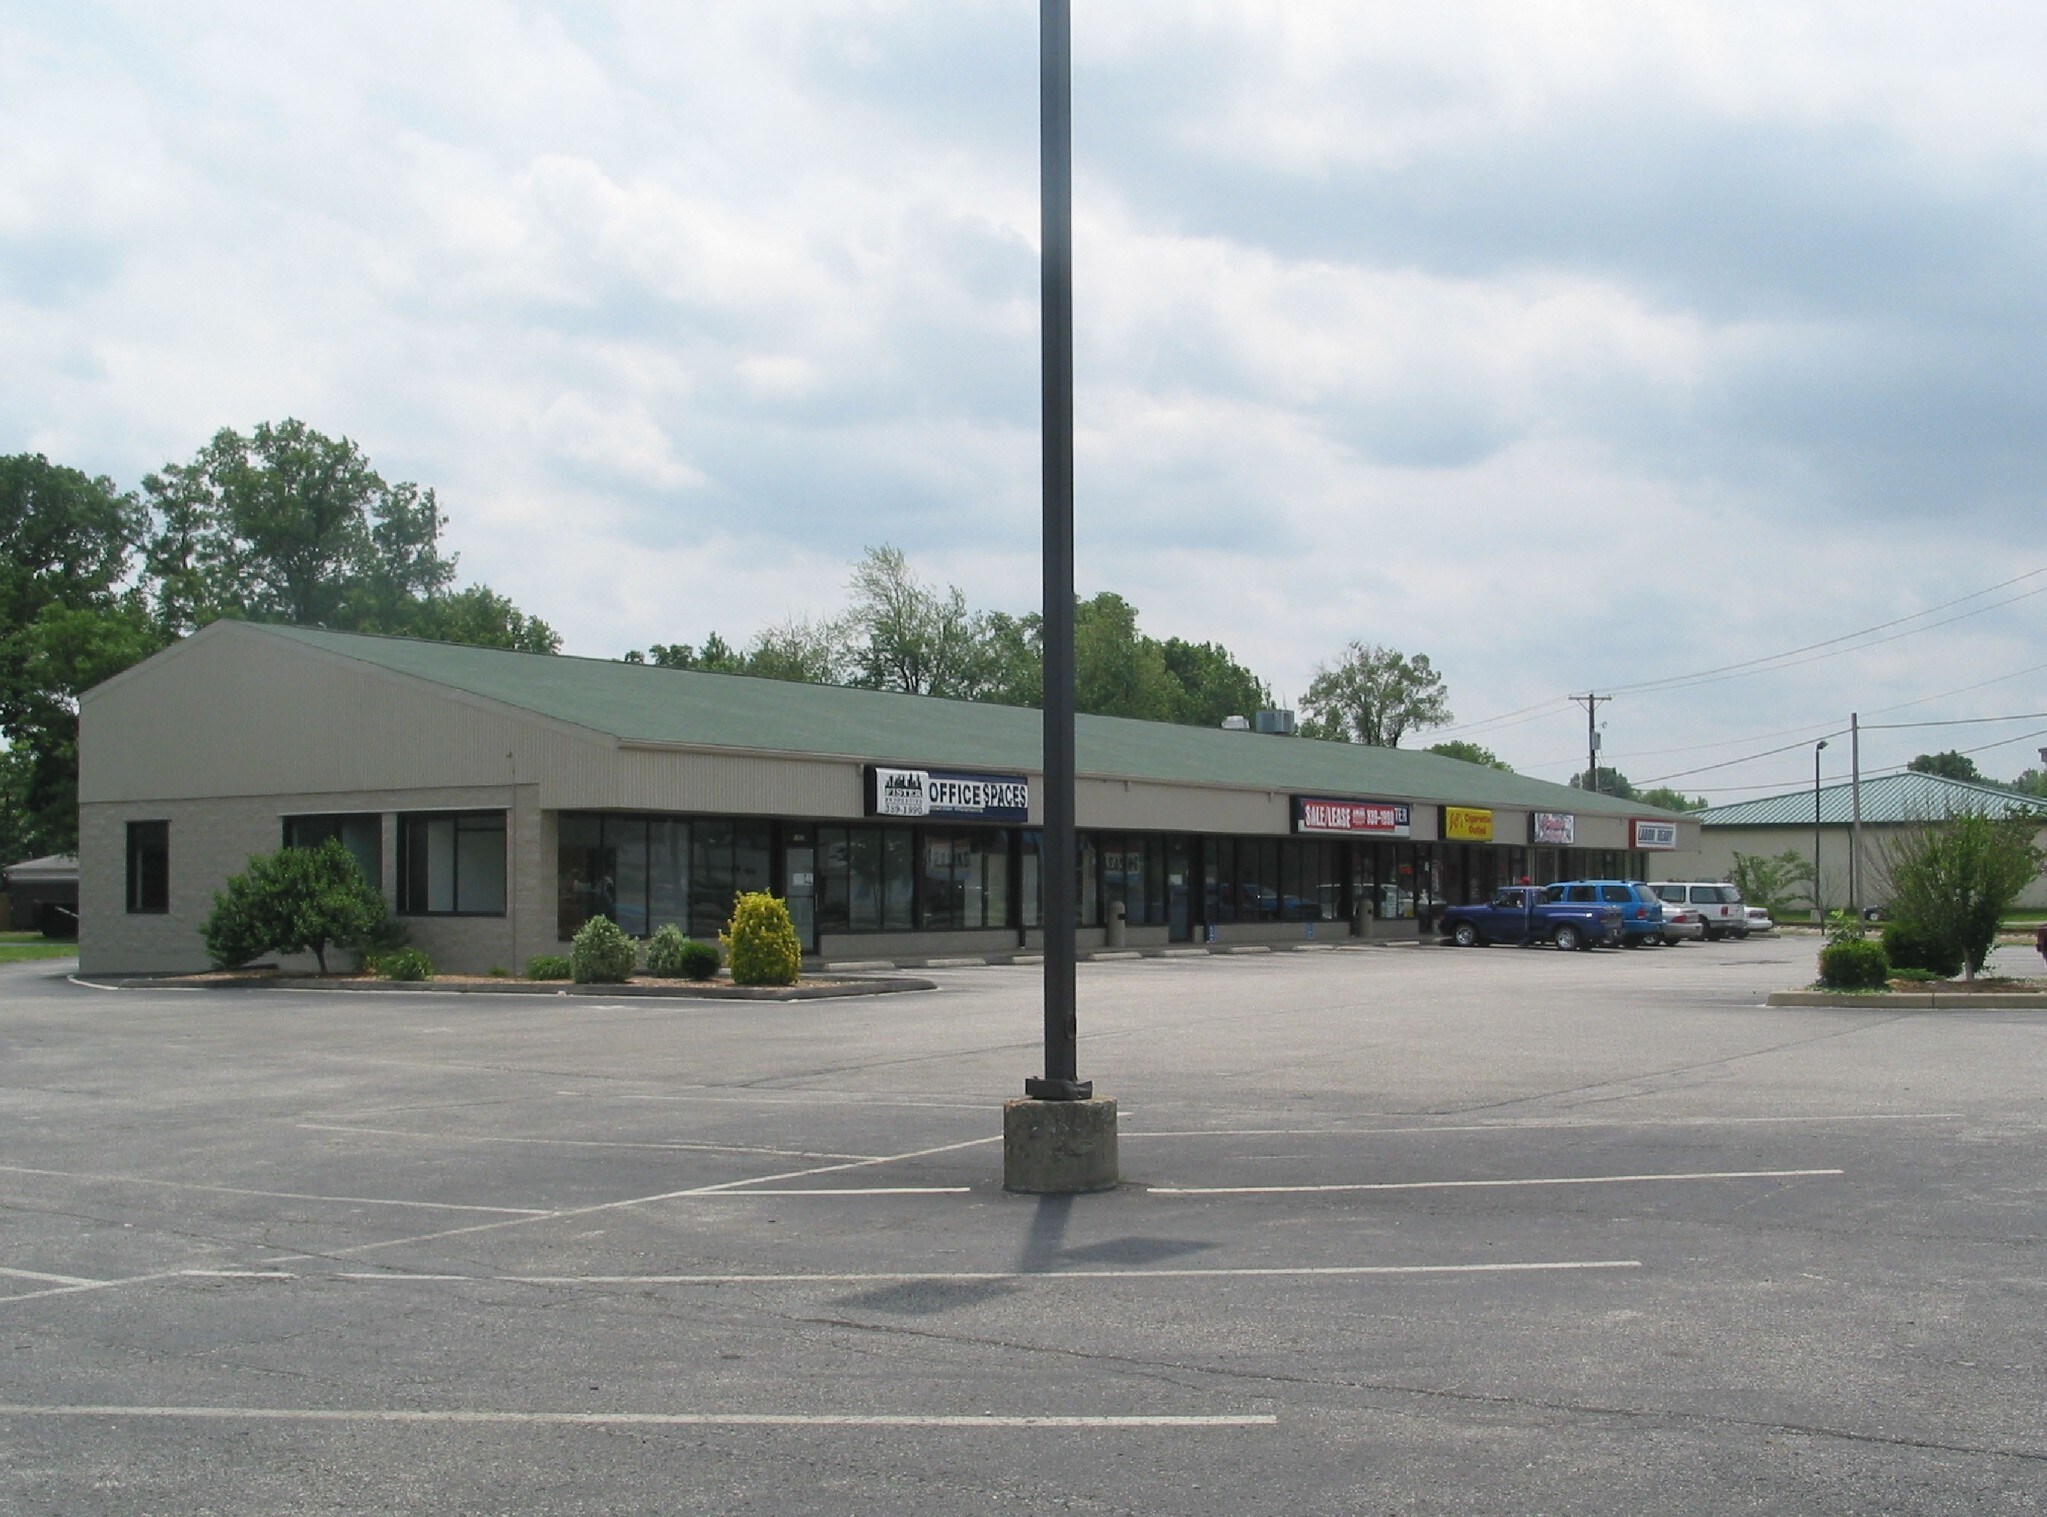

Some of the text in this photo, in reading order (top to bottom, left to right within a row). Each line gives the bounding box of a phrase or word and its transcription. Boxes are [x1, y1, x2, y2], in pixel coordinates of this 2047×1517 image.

[929, 782, 1026, 807] OFFICE SPACES
[1304, 804, 1351, 829] SALE/LEASE
